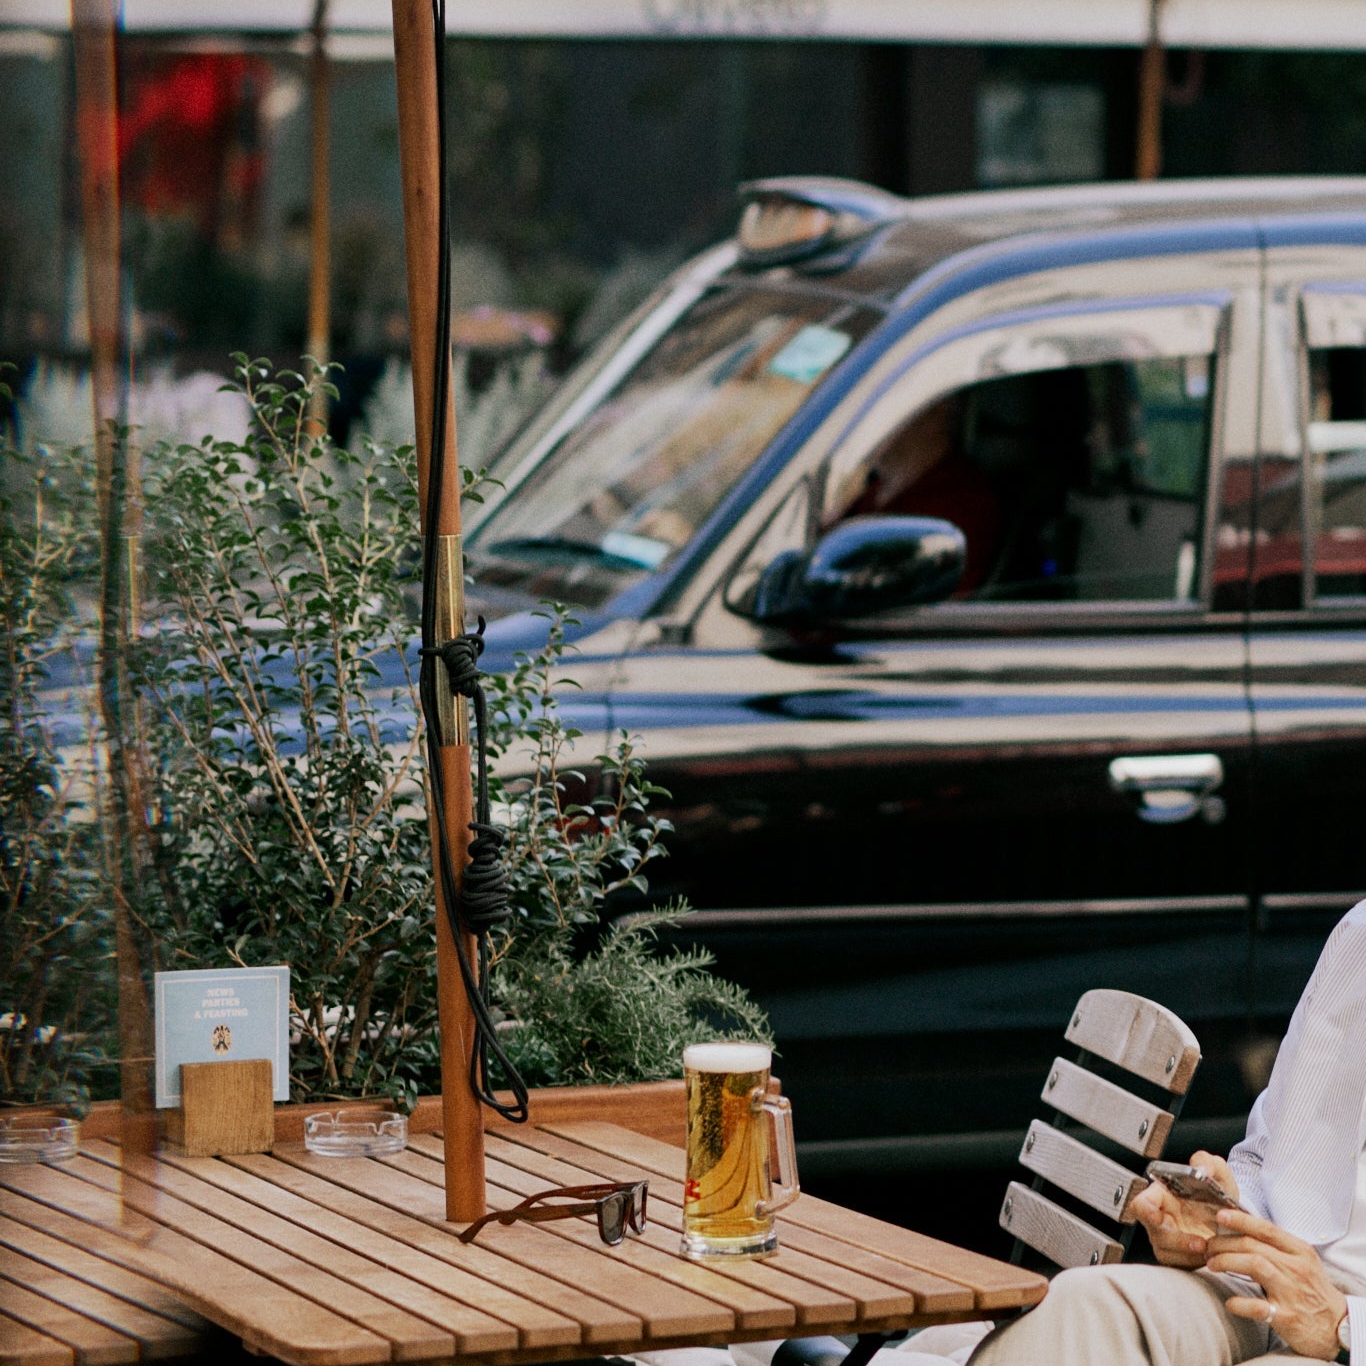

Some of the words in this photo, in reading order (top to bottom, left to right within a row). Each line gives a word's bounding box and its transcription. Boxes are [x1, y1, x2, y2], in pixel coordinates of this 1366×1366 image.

[207, 988, 235, 997] NEWS
[202, 997, 240, 1007] PARTIES
[203, 1008, 248, 1018] FEASTING
